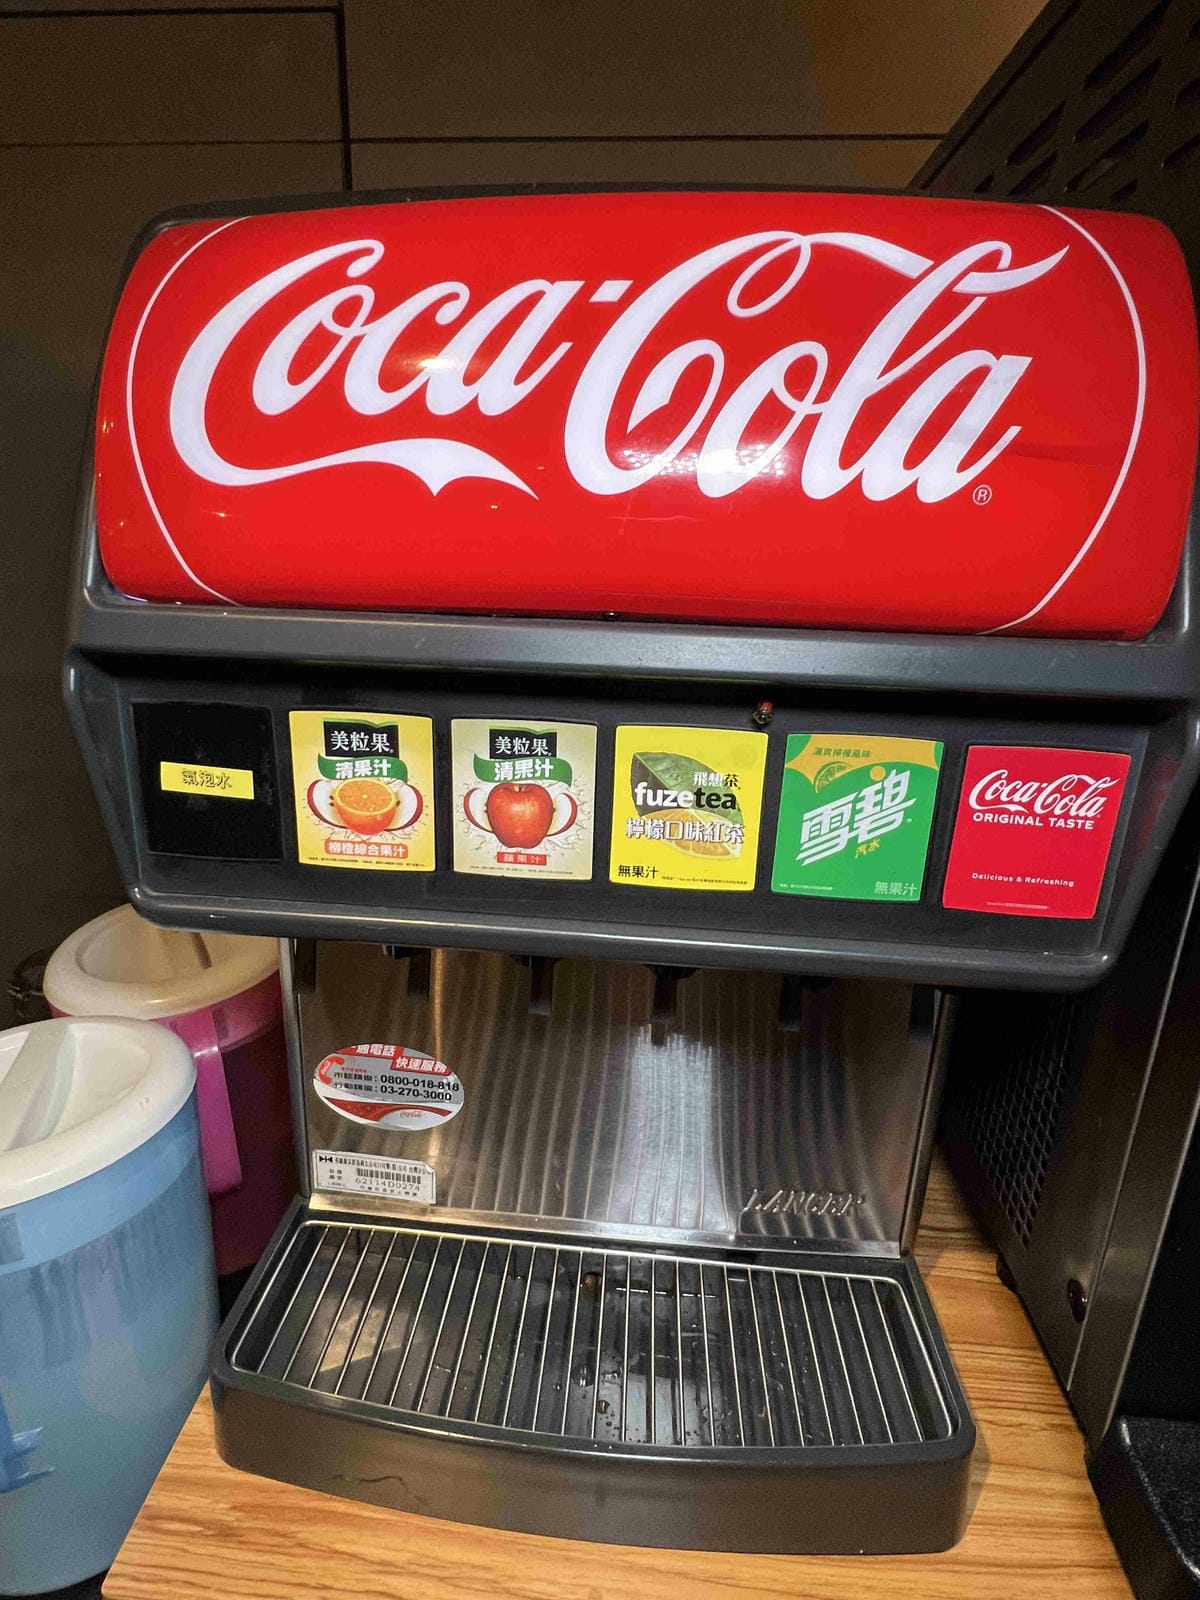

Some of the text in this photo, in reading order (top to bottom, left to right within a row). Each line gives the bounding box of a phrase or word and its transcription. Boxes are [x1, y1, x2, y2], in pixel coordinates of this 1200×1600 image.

[168, 230, 1070, 504] Coca-Cola
[330, 730, 391, 753] 美粒果
[495, 735, 549, 756] 美粒果
[181, 768, 232, 789] 氣泡水
[335, 759, 392, 779] 清果汁
[494, 759, 554, 781] 清果汁
[968, 769, 1120, 818] Coca-Cola
[795, 768, 917, 867] 雪碧
[972, 812, 1094, 830] ORIGINAL TASTE
[626, 817, 745, 844] 檸檬口味紅茶
[328, 841, 406, 858] 柳橙綜合果汁
[854, 838, 880, 859] 汽水
[618, 864, 659, 879] 無果汁
[971, 872, 1013, 883] Delicious
[1025, 876, 1074, 887] Refreshing
[874, 880, 918, 897] 無果汁
[395, 1056, 447, 1073] 快速服務
[380, 1084, 452, 1102] 03-270-3000
